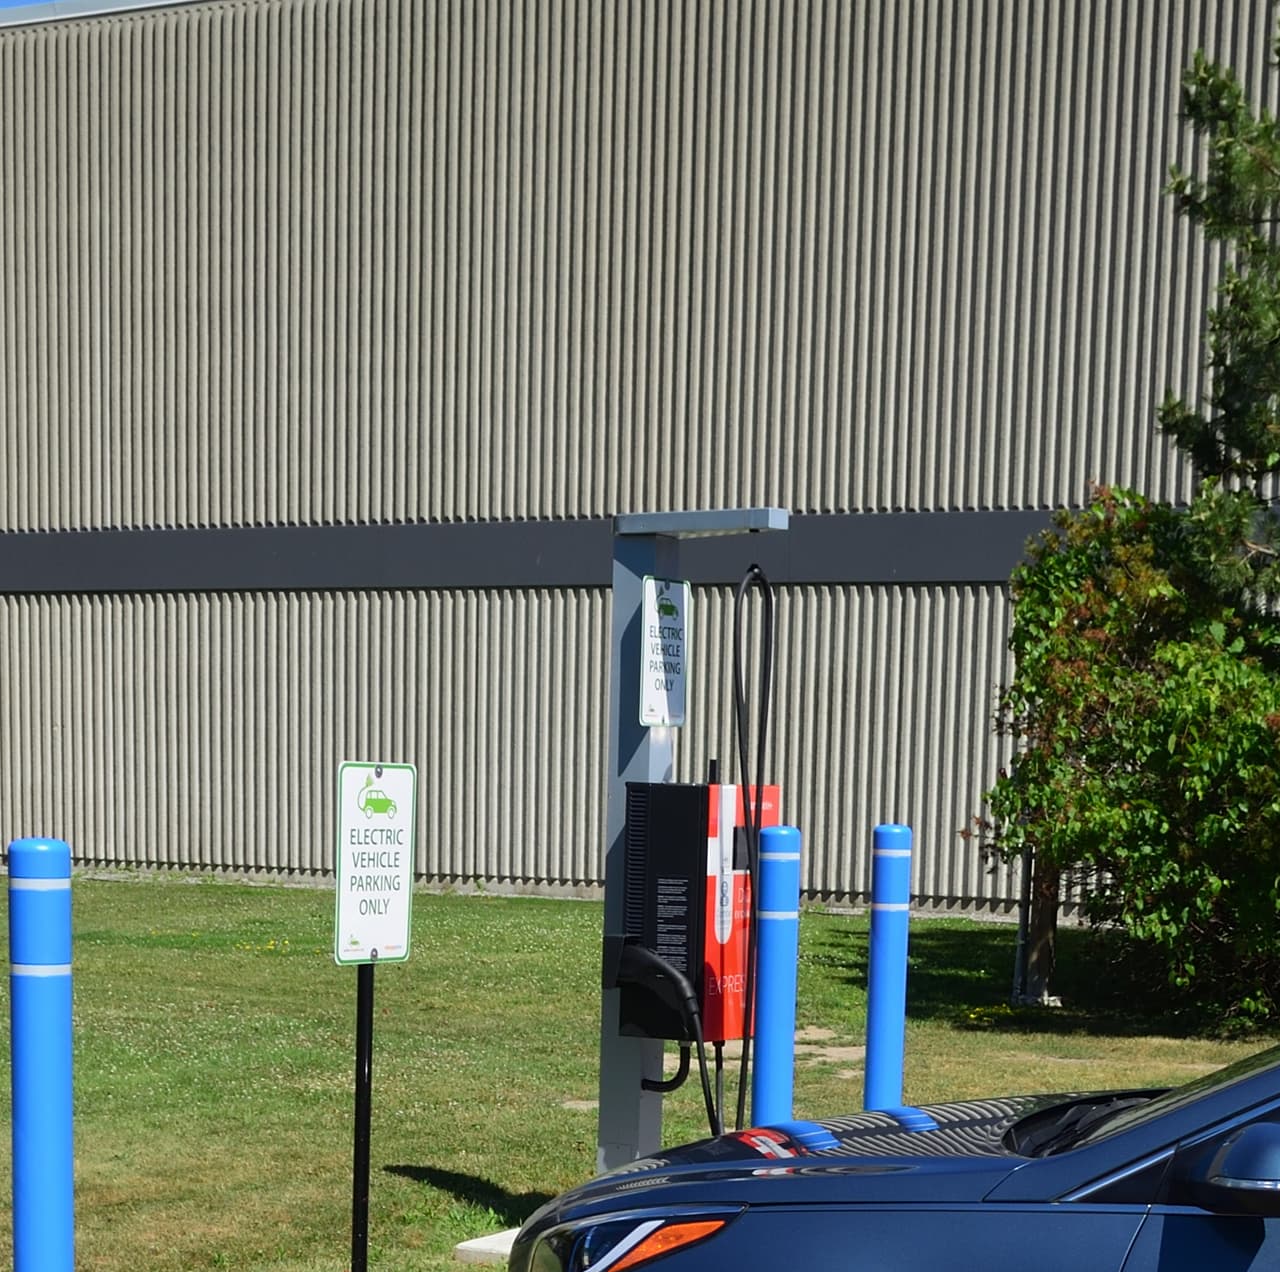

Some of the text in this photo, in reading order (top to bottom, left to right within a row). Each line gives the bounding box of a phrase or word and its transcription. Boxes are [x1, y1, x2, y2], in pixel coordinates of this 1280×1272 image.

[649, 626, 683, 641] ELECTRIC
[650, 643, 681, 657] VEHICLE
[649, 660, 681, 675] PARKING
[654, 678, 674, 692] ONLY
[350, 828, 404, 846] ELECTRIC
[352, 851, 400, 869] VEHICLE
[350, 875, 401, 892] PARKING
[359, 899, 390, 916] ONLY
